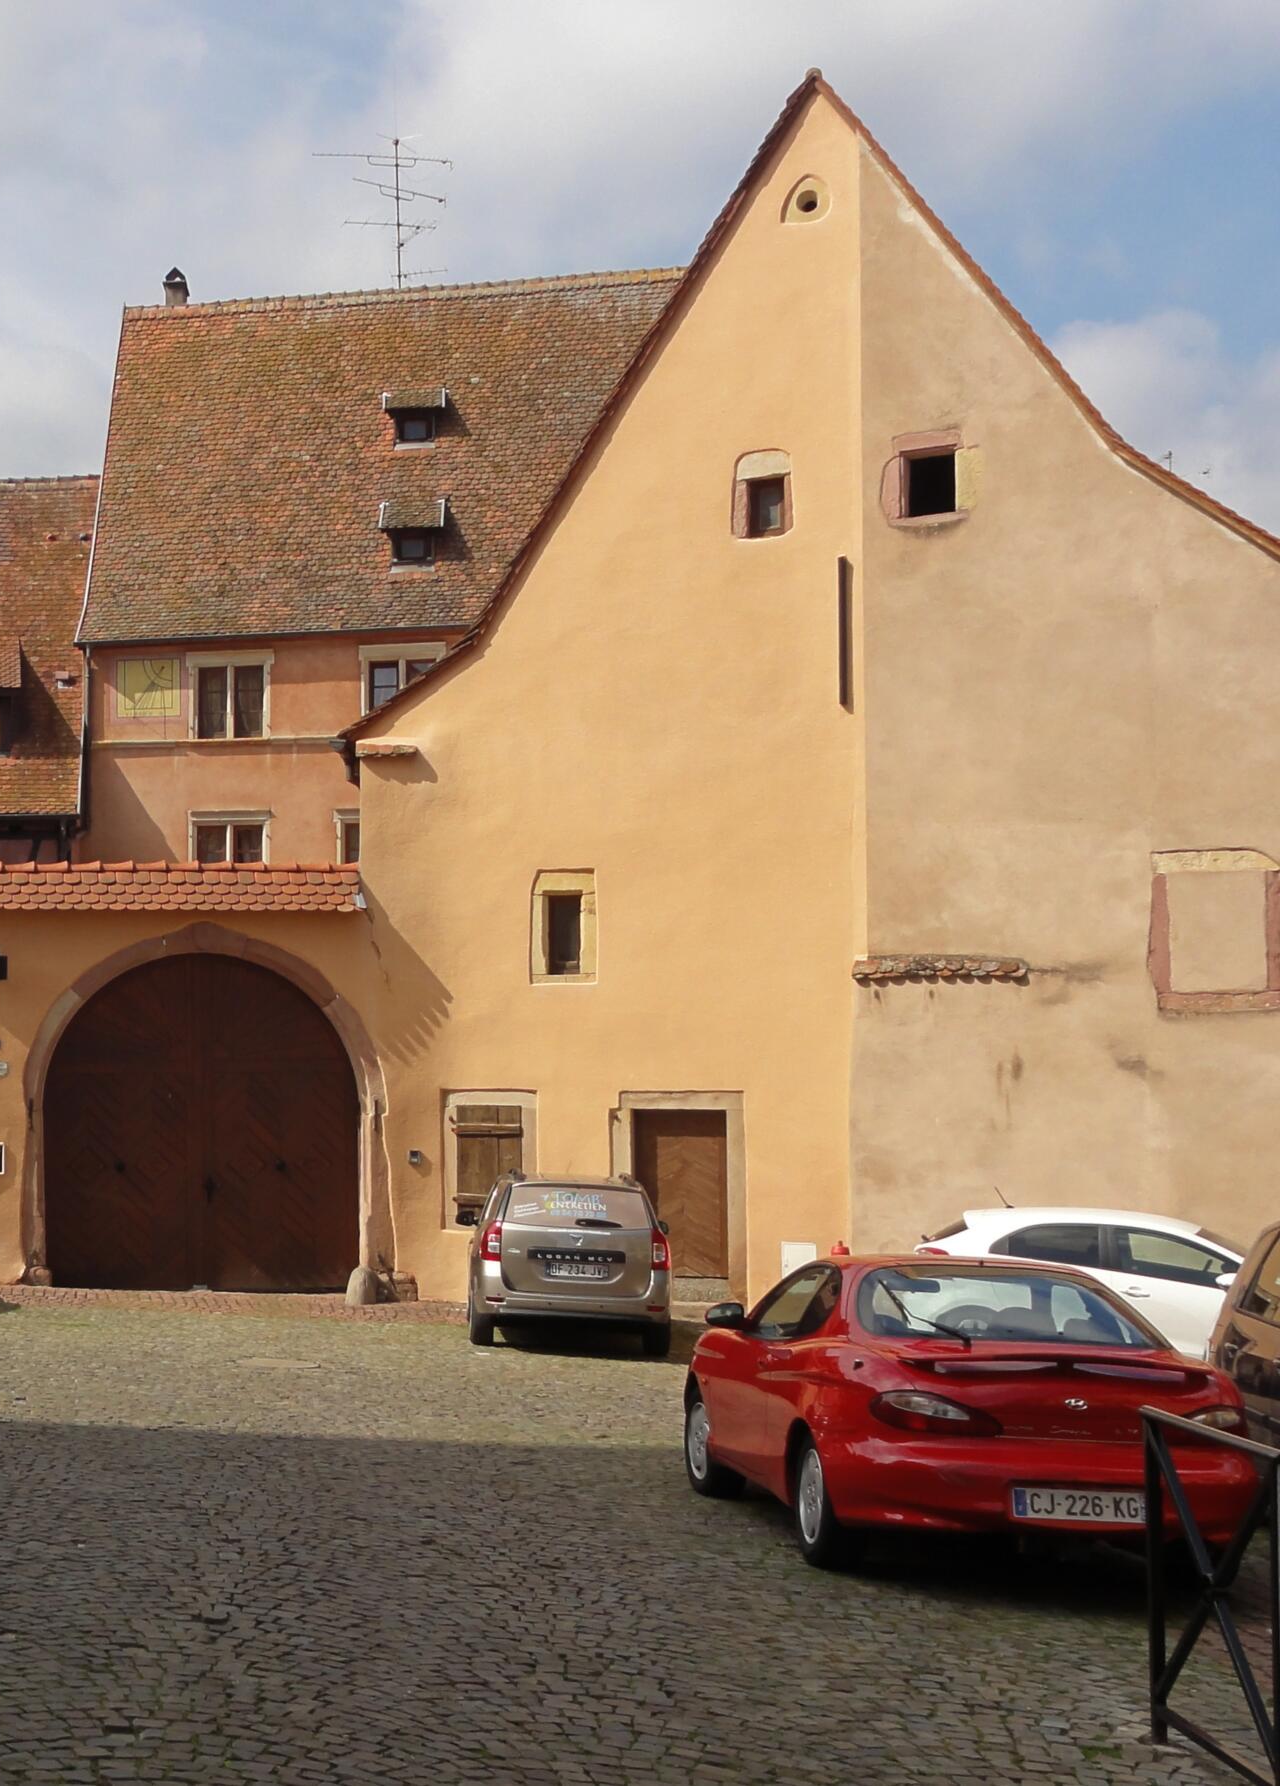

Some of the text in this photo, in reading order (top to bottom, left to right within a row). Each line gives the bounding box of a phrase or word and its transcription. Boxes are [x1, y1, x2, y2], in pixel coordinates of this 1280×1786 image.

[550, 1201, 607, 1211] ENTRETIEN
[537, 1253, 580, 1261] LOGAN
[1030, 1492, 1139, 1519] CJ-226-KG
